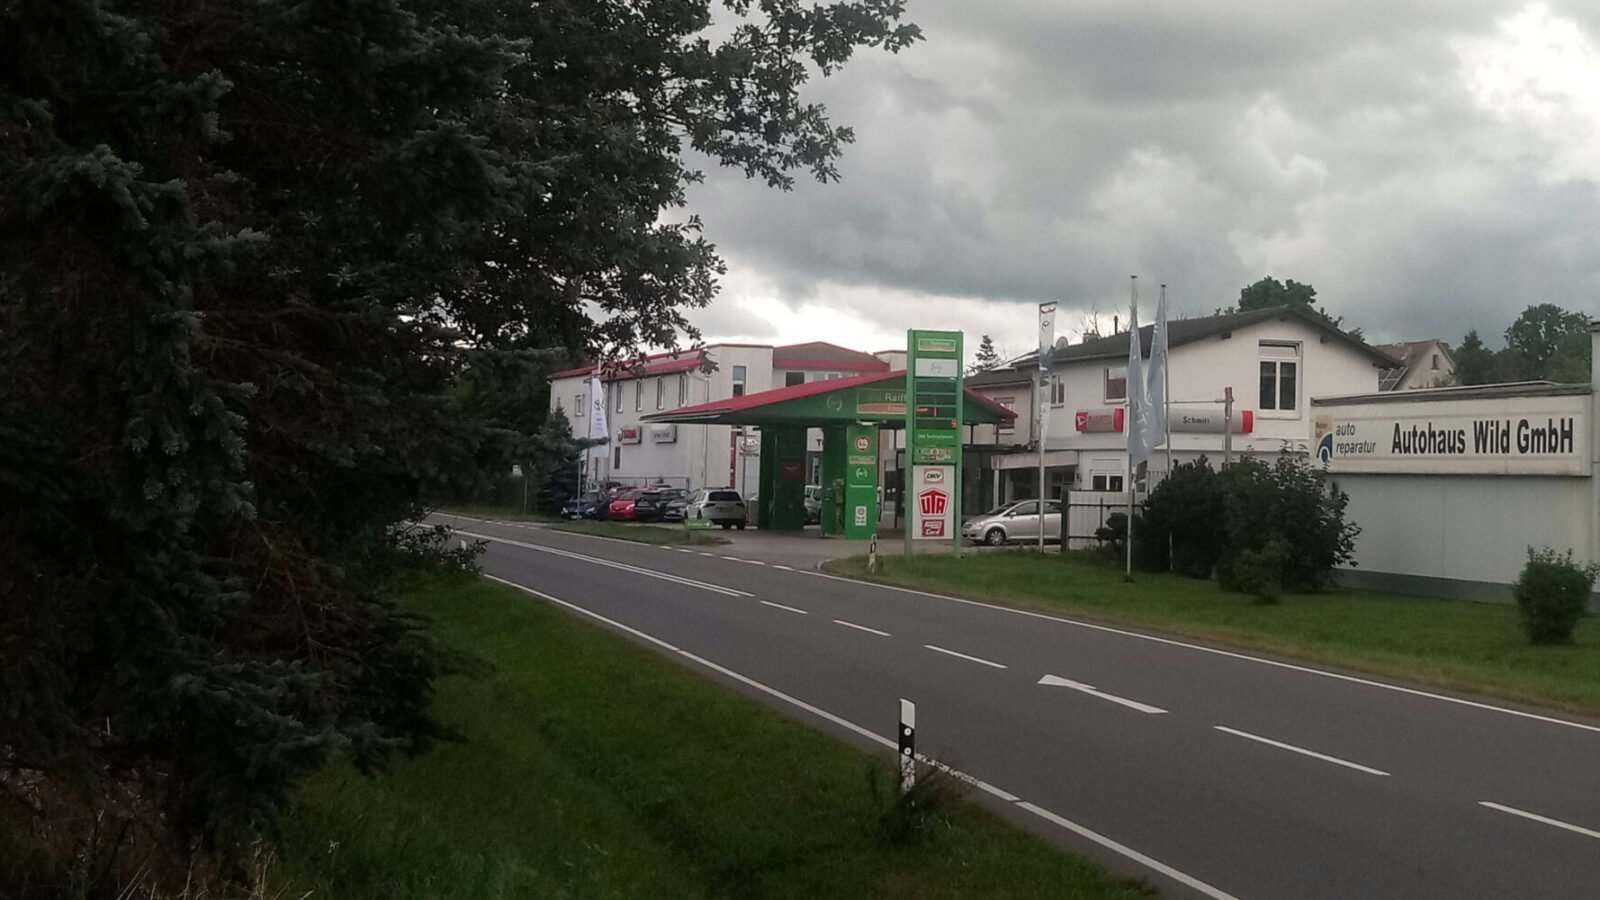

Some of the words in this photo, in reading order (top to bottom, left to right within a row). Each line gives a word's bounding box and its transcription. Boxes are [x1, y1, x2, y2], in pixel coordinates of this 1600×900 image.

[1335, 421, 1356, 437] auto
[1391, 422, 1466, 455] Autohaus
[1473, 420, 1511, 454] Wild
[1516, 418, 1574, 454] GmbH
[1335, 439, 1377, 457] reparatur
[920, 490, 947, 514] UTA
